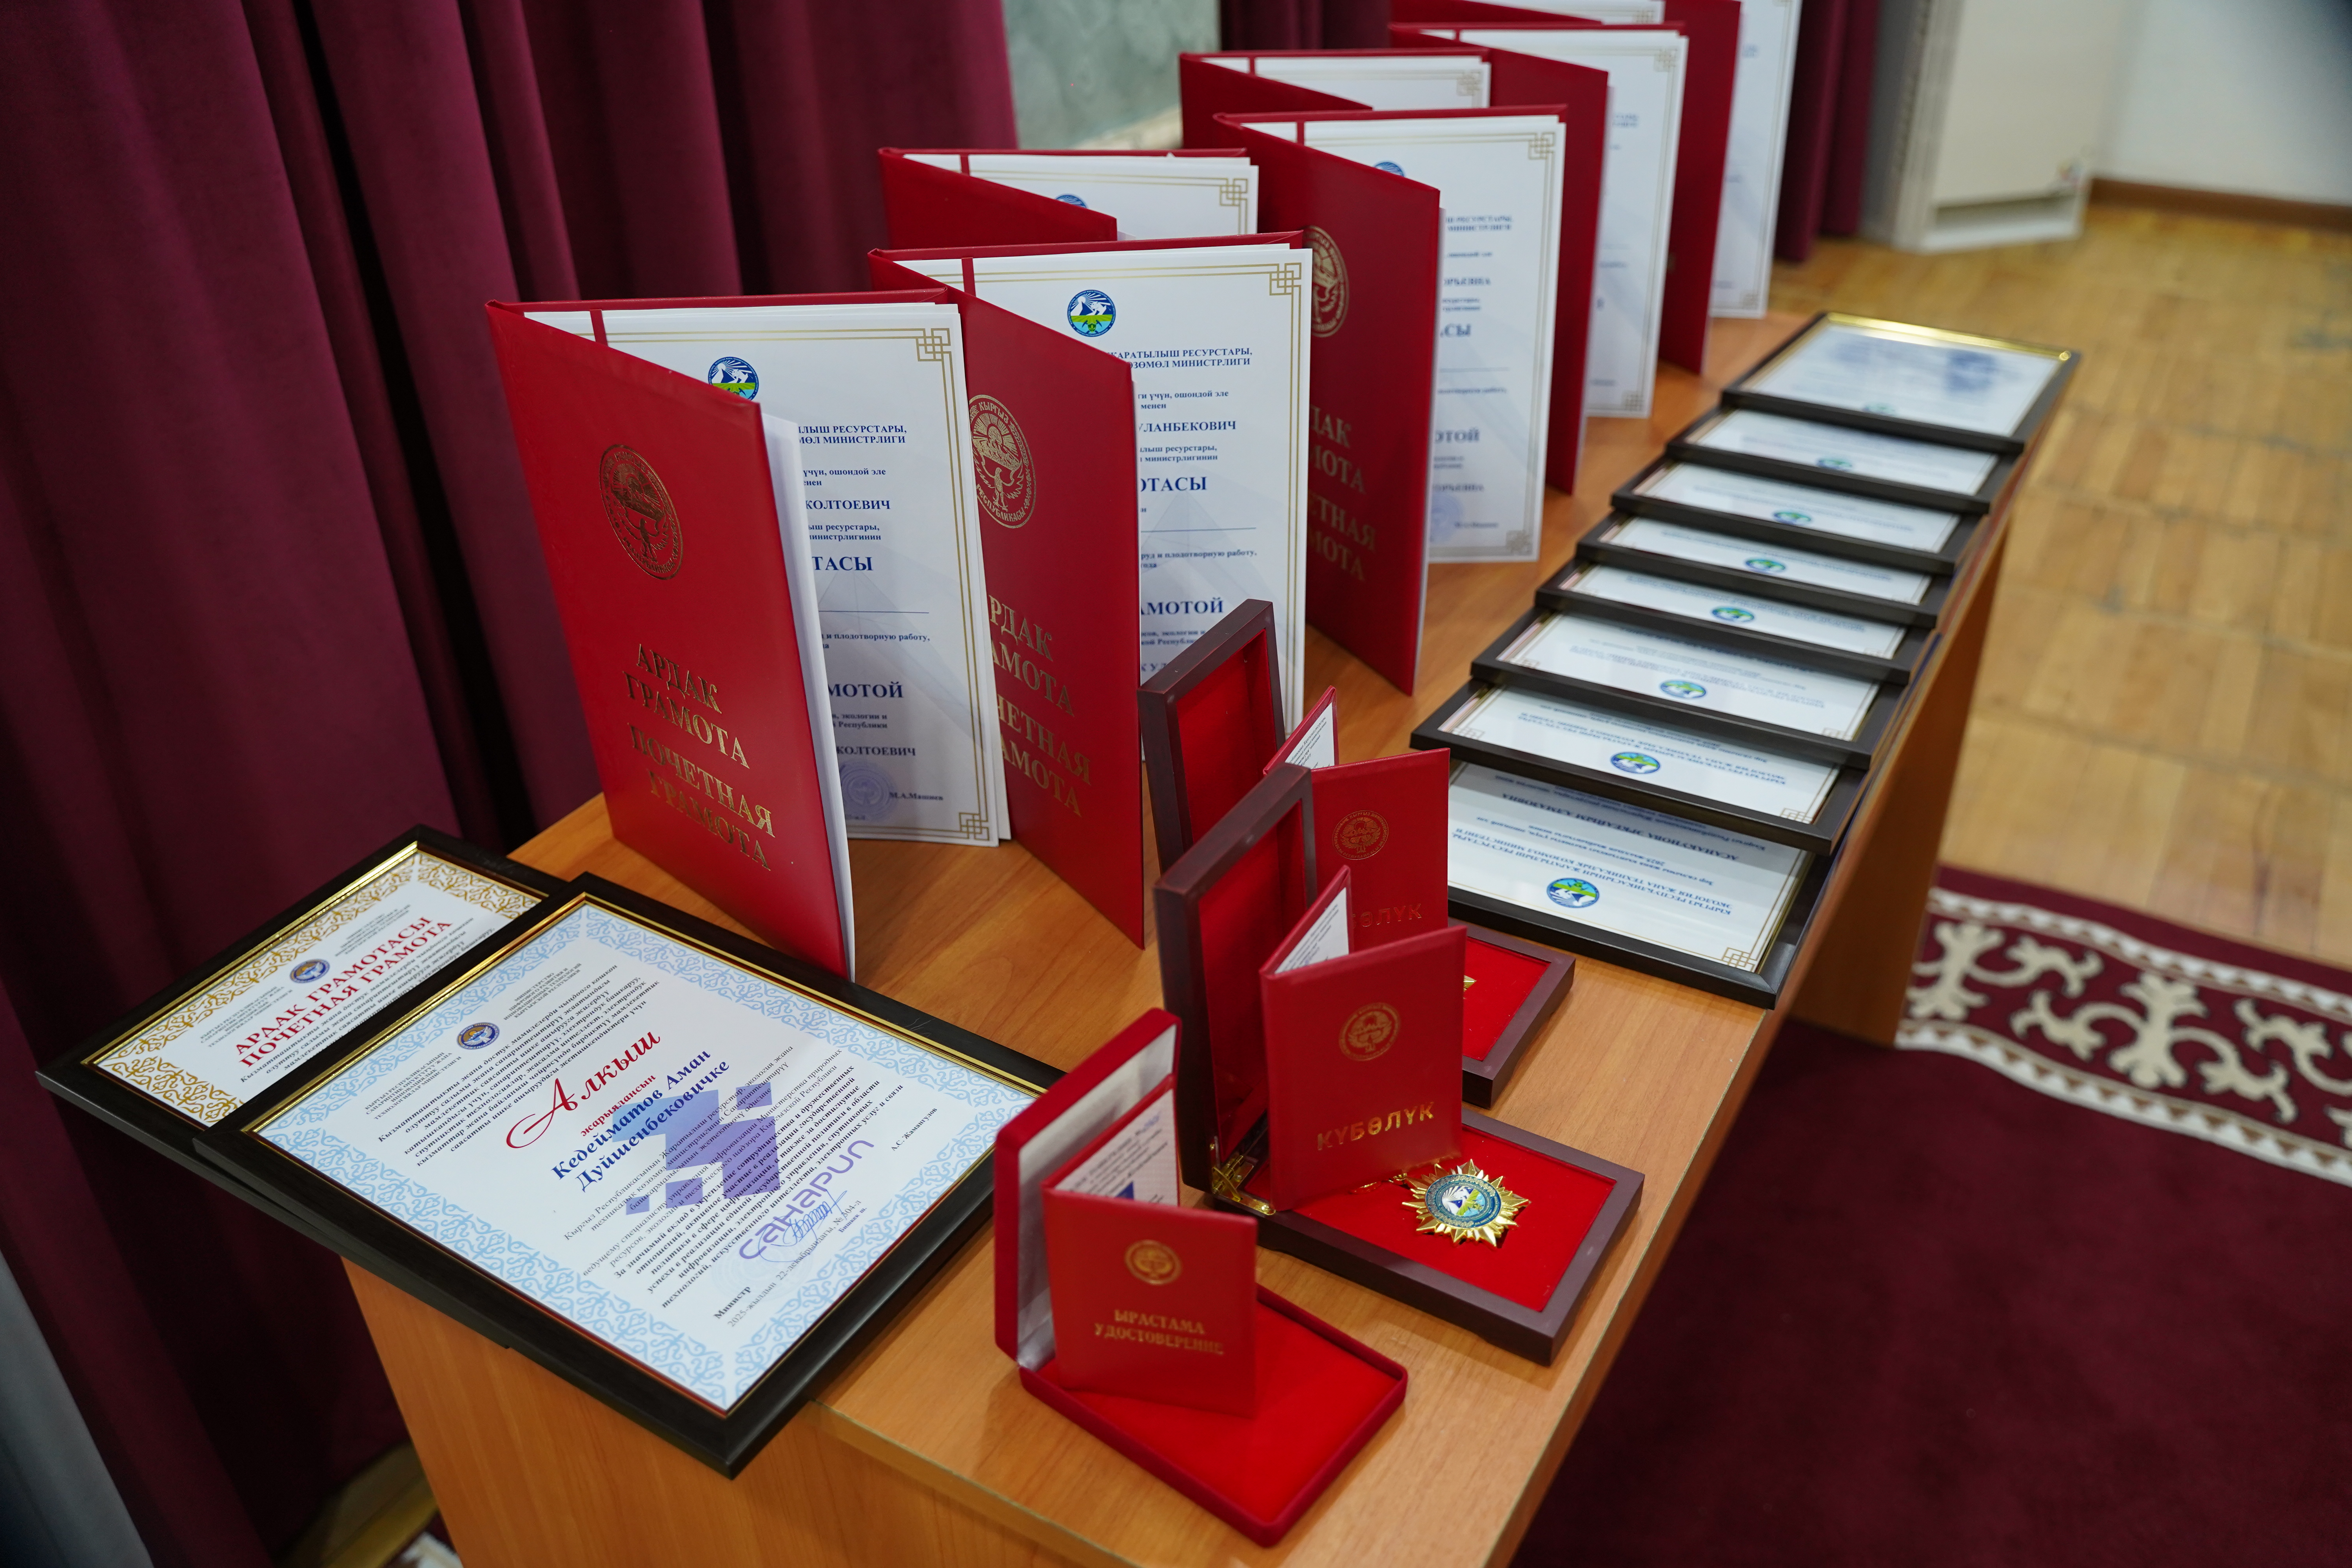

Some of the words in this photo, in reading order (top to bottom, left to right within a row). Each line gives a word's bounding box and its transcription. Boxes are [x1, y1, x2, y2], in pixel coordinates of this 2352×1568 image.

[1172, 358, 1249, 367] МИНИСТРЛИГИ
[1183, 348, 1252, 356] РЕСУРСТАРЫ,
[1141, 477, 1207, 492] ТАСЫ
[1227, 549, 1257, 558] работу,
[989, 595, 1054, 661] РДАК
[1141, 597, 1223, 615] МОТОЙ
[622, 671, 750, 769] ГРАМОТА
[636, 643, 722, 714] АРДАК
[828, 681, 903, 698] МОТОЙ
[992, 638, 1075, 717] МОТА
[628, 722, 775, 838] ПОЧЕТНАЯ
[997, 694, 1091, 785] ЕТНАЯ
[1000, 734, 1082, 818] МОТА
[647, 769, 771, 871] ГРАМОТА
[1352, 904, 1422, 929] ӨЛҮК
[236, 1004, 306, 1055] АРДАК
[307, 918, 431, 1002] ГРАМОТАСЫ
[240, 985, 359, 1067] ПОЧЕТНАЯ
[360, 923, 452, 983] ГРАМОТА
[378, 1082, 460, 1142] Кызматташтыкты
[461, 1065, 483, 1082] жана
[484, 1045, 510, 1065] достук
[511, 1009, 558, 1045] мамилелерди
[592, 965, 617, 984] кошкон
[405, 1107, 467, 1154] катышкандыгы
[468, 1092, 489, 1107] үчүн,
[490, 1038, 561, 1090] санариптештирүү,
[561, 1002, 606, 1035] электрондук
[606, 978, 640, 1002] башкаруу,
[406, 1107, 439, 1132] олуттуу
[441, 1083, 471, 1106] салымы
[472, 1067, 494, 1083] жана
[495, 1016, 563, 1066] санариптештирүү
[564, 980, 610, 1015] жаатындагы
[416, 1118, 466, 1157] спутниктик
[466, 1074, 526, 1118] технологиялар,
[526, 1047, 560, 1073] жасалма
[561, 1016, 603, 1047] интеллект,
[604, 982, 646, 1014] электрондук
[425, 1087, 479, 1129] мамлекеттик
[481, 1058, 519, 1087] саясатты
[520, 1042, 539, 1057] ишке
[541, 1016, 575, 1042] ашырууга
[575, 991, 609, 1016] жигердүү
[506, 1032, 660, 1148] Алкыш
[552, 1090, 662, 1179] Кедейматов
[667, 1051, 710, 1090] Аман
[564, 1214, 595, 1240] Кыргыз
[595, 1159, 661, 1214] Республикасынын
[659, 1119, 707, 1159] Жаратылыш
[707, 1089, 745, 1120] ресурстар,
[745, 1063, 774, 1087] экология
[774, 1046, 793, 1063] жана
[576, 1062, 729, 1192] Дуйшенбековичке
[581, 1075, 656, 1136] жарыялансын
[591, 1192, 637, 1231] техникалык
[637, 1166, 667, 1192] көзөмөл
[667, 1117, 724, 1166] министрлигинин
[724, 1062, 788, 1116] Санариптештирүү
[630, 1151, 699, 1210] башкармалыгынын
[699, 1111, 745, 1151] жетектөөчү
[745, 1088, 771, 1112] адисине
[891, 1140, 904, 1151] А.С.
[902, 1109, 937, 1139] Жамангулов
[1316, 1102, 1435, 1151] КҮБӨЛҮК
[628, 1233, 666, 1267] значимый
[667, 1212, 688, 1232] вклад
[695, 1171, 736, 1209] укрепление
[737, 1119, 795, 1170] сотрудничества
[800, 1066, 854, 1113] дружественных
[637, 1232, 685, 1274] отношений,
[686, 1197, 721, 1230] активное
[722, 1169, 752, 1199] участие
[758, 1128, 799, 1165] реализации
[799, 1078, 855, 1128] государственной
[838, 1214, 860, 1232] Бишкек
[714, 1287, 751, 1319] Министр
[1094, 1323, 1224, 1356] УДОСТОВЕРЕНИЕ
[1114, 1309, 1205, 1334] ЫРАСТАМА
